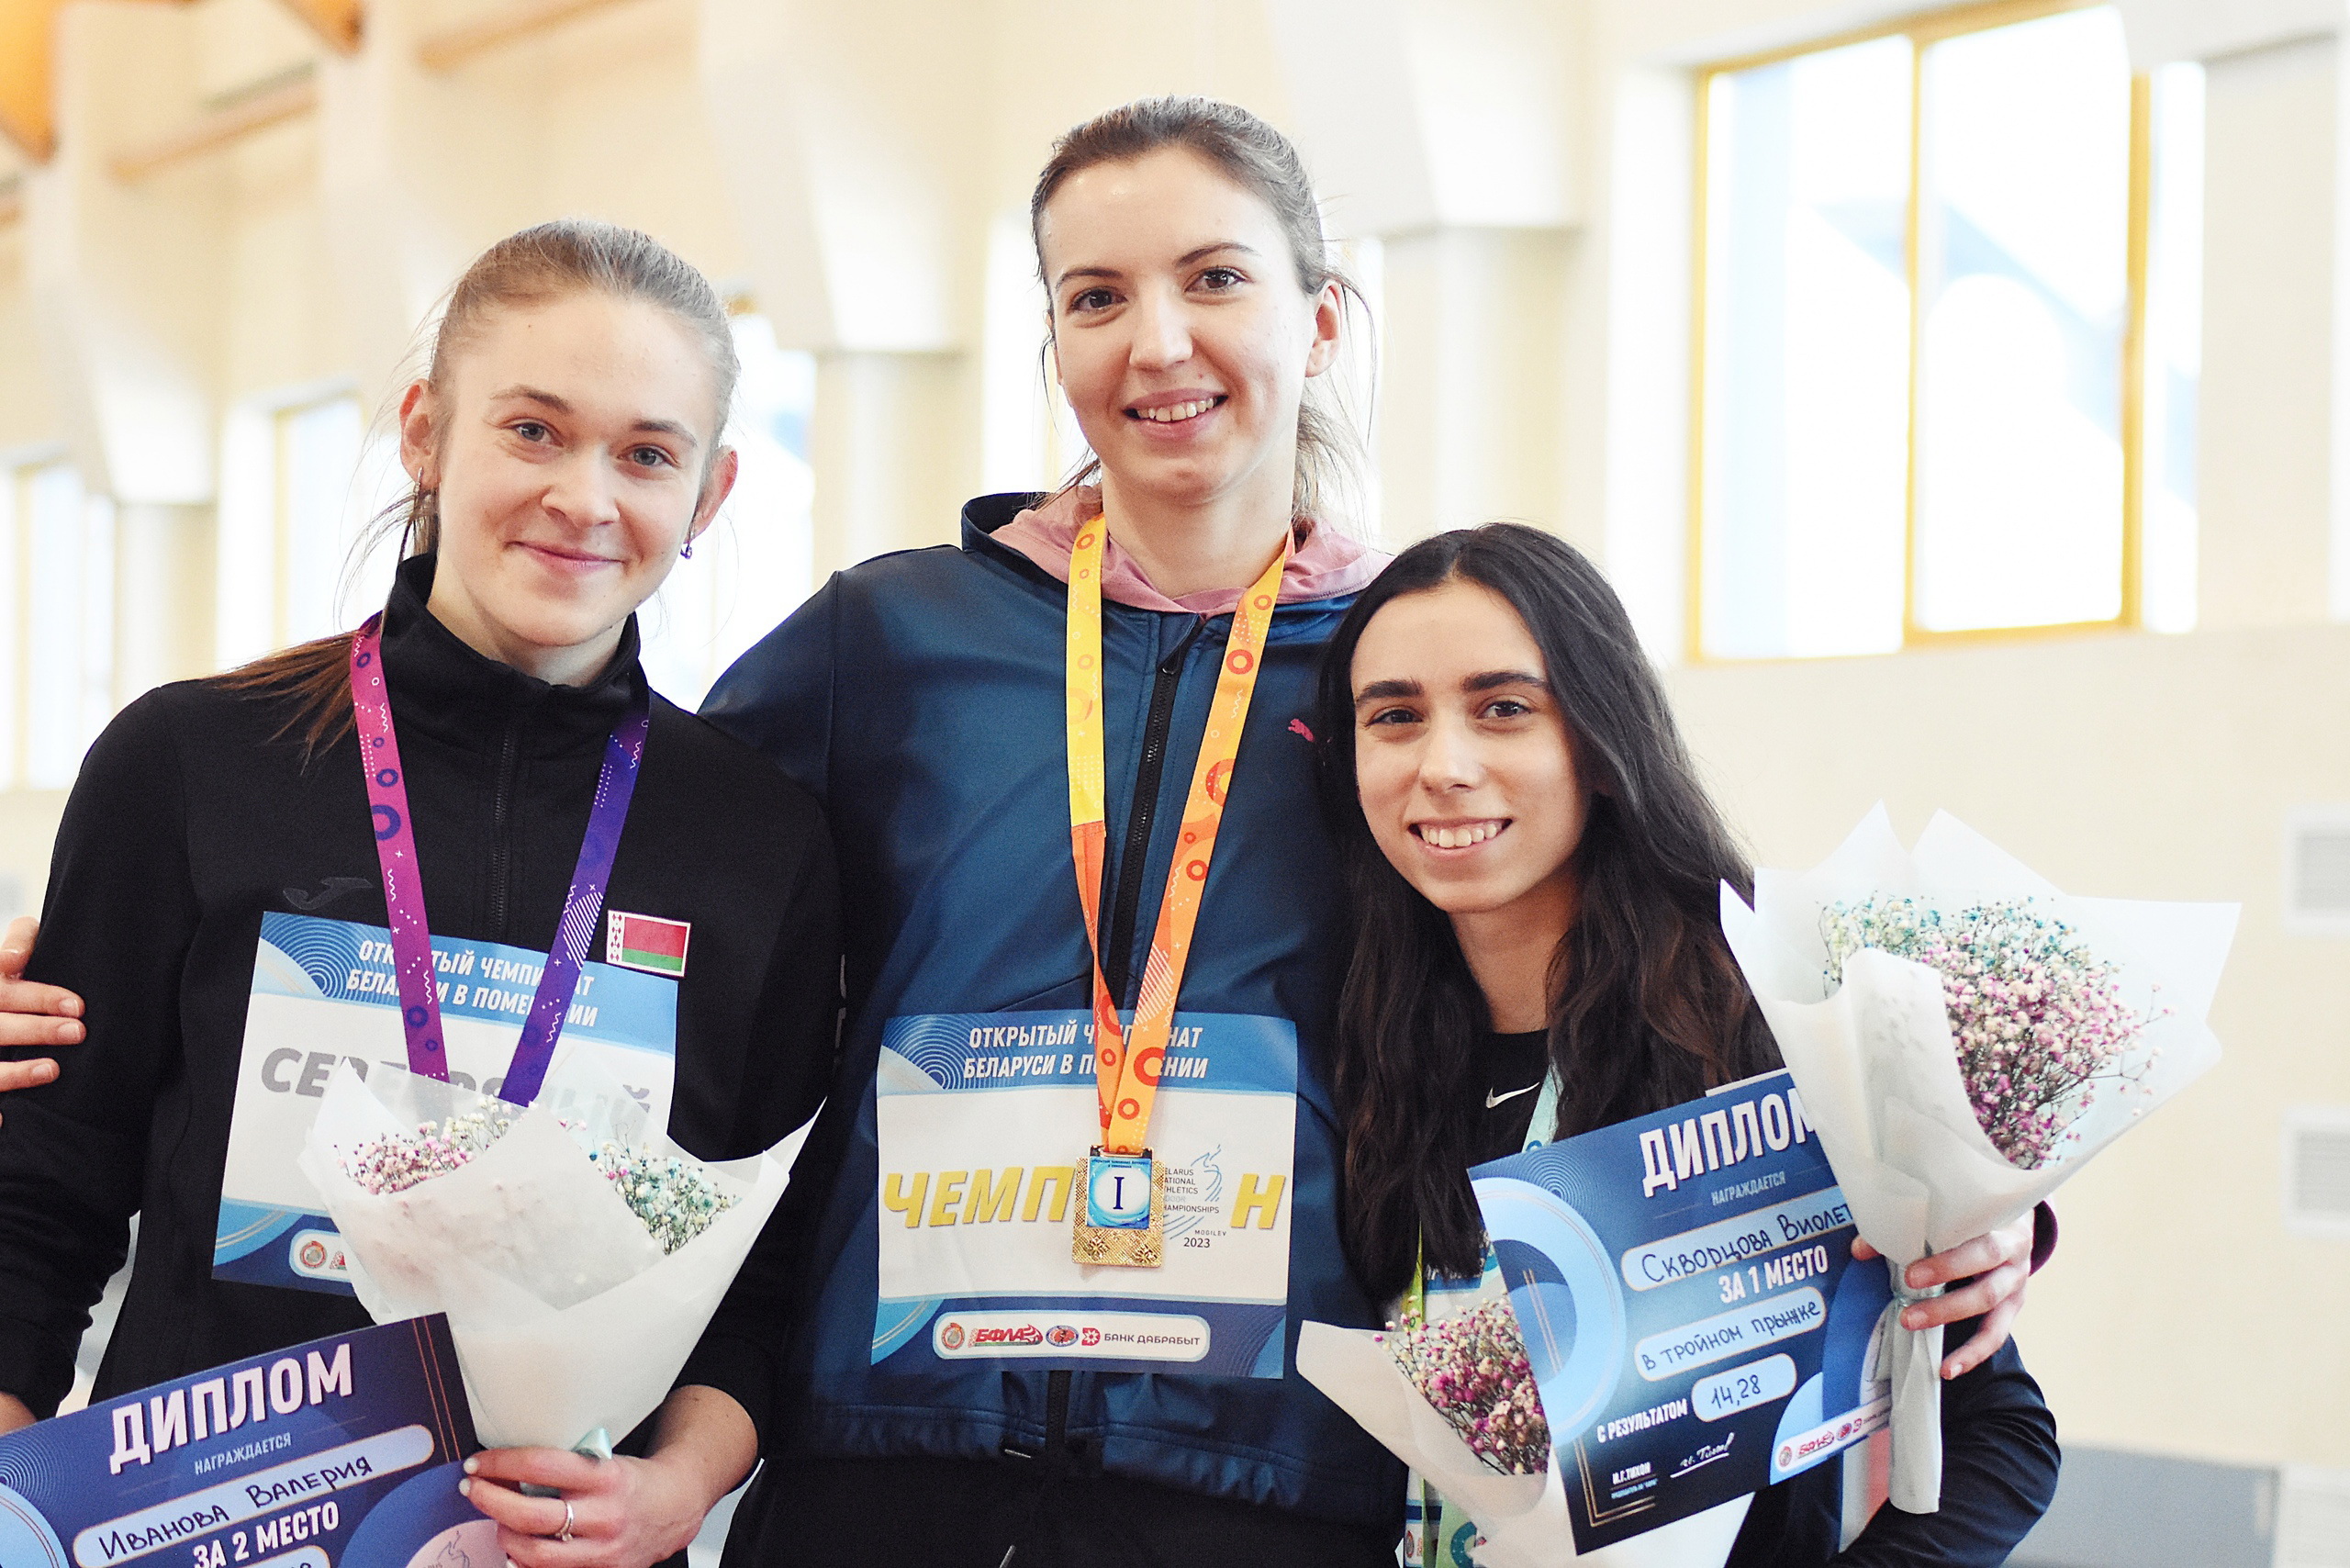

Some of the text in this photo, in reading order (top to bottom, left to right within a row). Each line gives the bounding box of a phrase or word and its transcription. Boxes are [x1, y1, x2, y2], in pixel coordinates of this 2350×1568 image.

[359, 940, 595, 996] ОТКТЫЙ ЧЕМПИАТ
[346, 969, 598, 1026] БЕЛАИ В ПОМЕИИ
[969, 1019, 1078, 1048] ОТКРЫТЫЙ
[964, 1054, 1057, 1078] БЕЛАРУСИ
[1059, 1054, 1073, 1075] В
[1165, 1167, 1194, 1176] ELARUS
[1165, 1177, 1196, 1186] ATIONAL
[1711, 1170, 1786, 1205] НАГРАЖДАЕТСЯ
[884, 1167, 1286, 1228] ЧЕМПН
[1165, 1186, 1199, 1194] HLETICS
[1164, 1204, 1220, 1214] HAMPIONSHIPS
[1183, 1238, 1211, 1249] 2023
[1718, 1245, 1829, 1304] ЗА 1 МЕСТО
[1104, 1333, 1201, 1346] БАНК ДАБРАБЫТ
[109, 1343, 352, 1474] ДИПЛОМ
[1711, 1374, 1762, 1409] 14,28
[1597, 1398, 1687, 1443] С РЕЗУЛЬТАТОМ
[195, 1432, 292, 1476] НАГРАЖДАЕТСЯ
[193, 1500, 340, 1568] ЗА 2 МЕСТО
